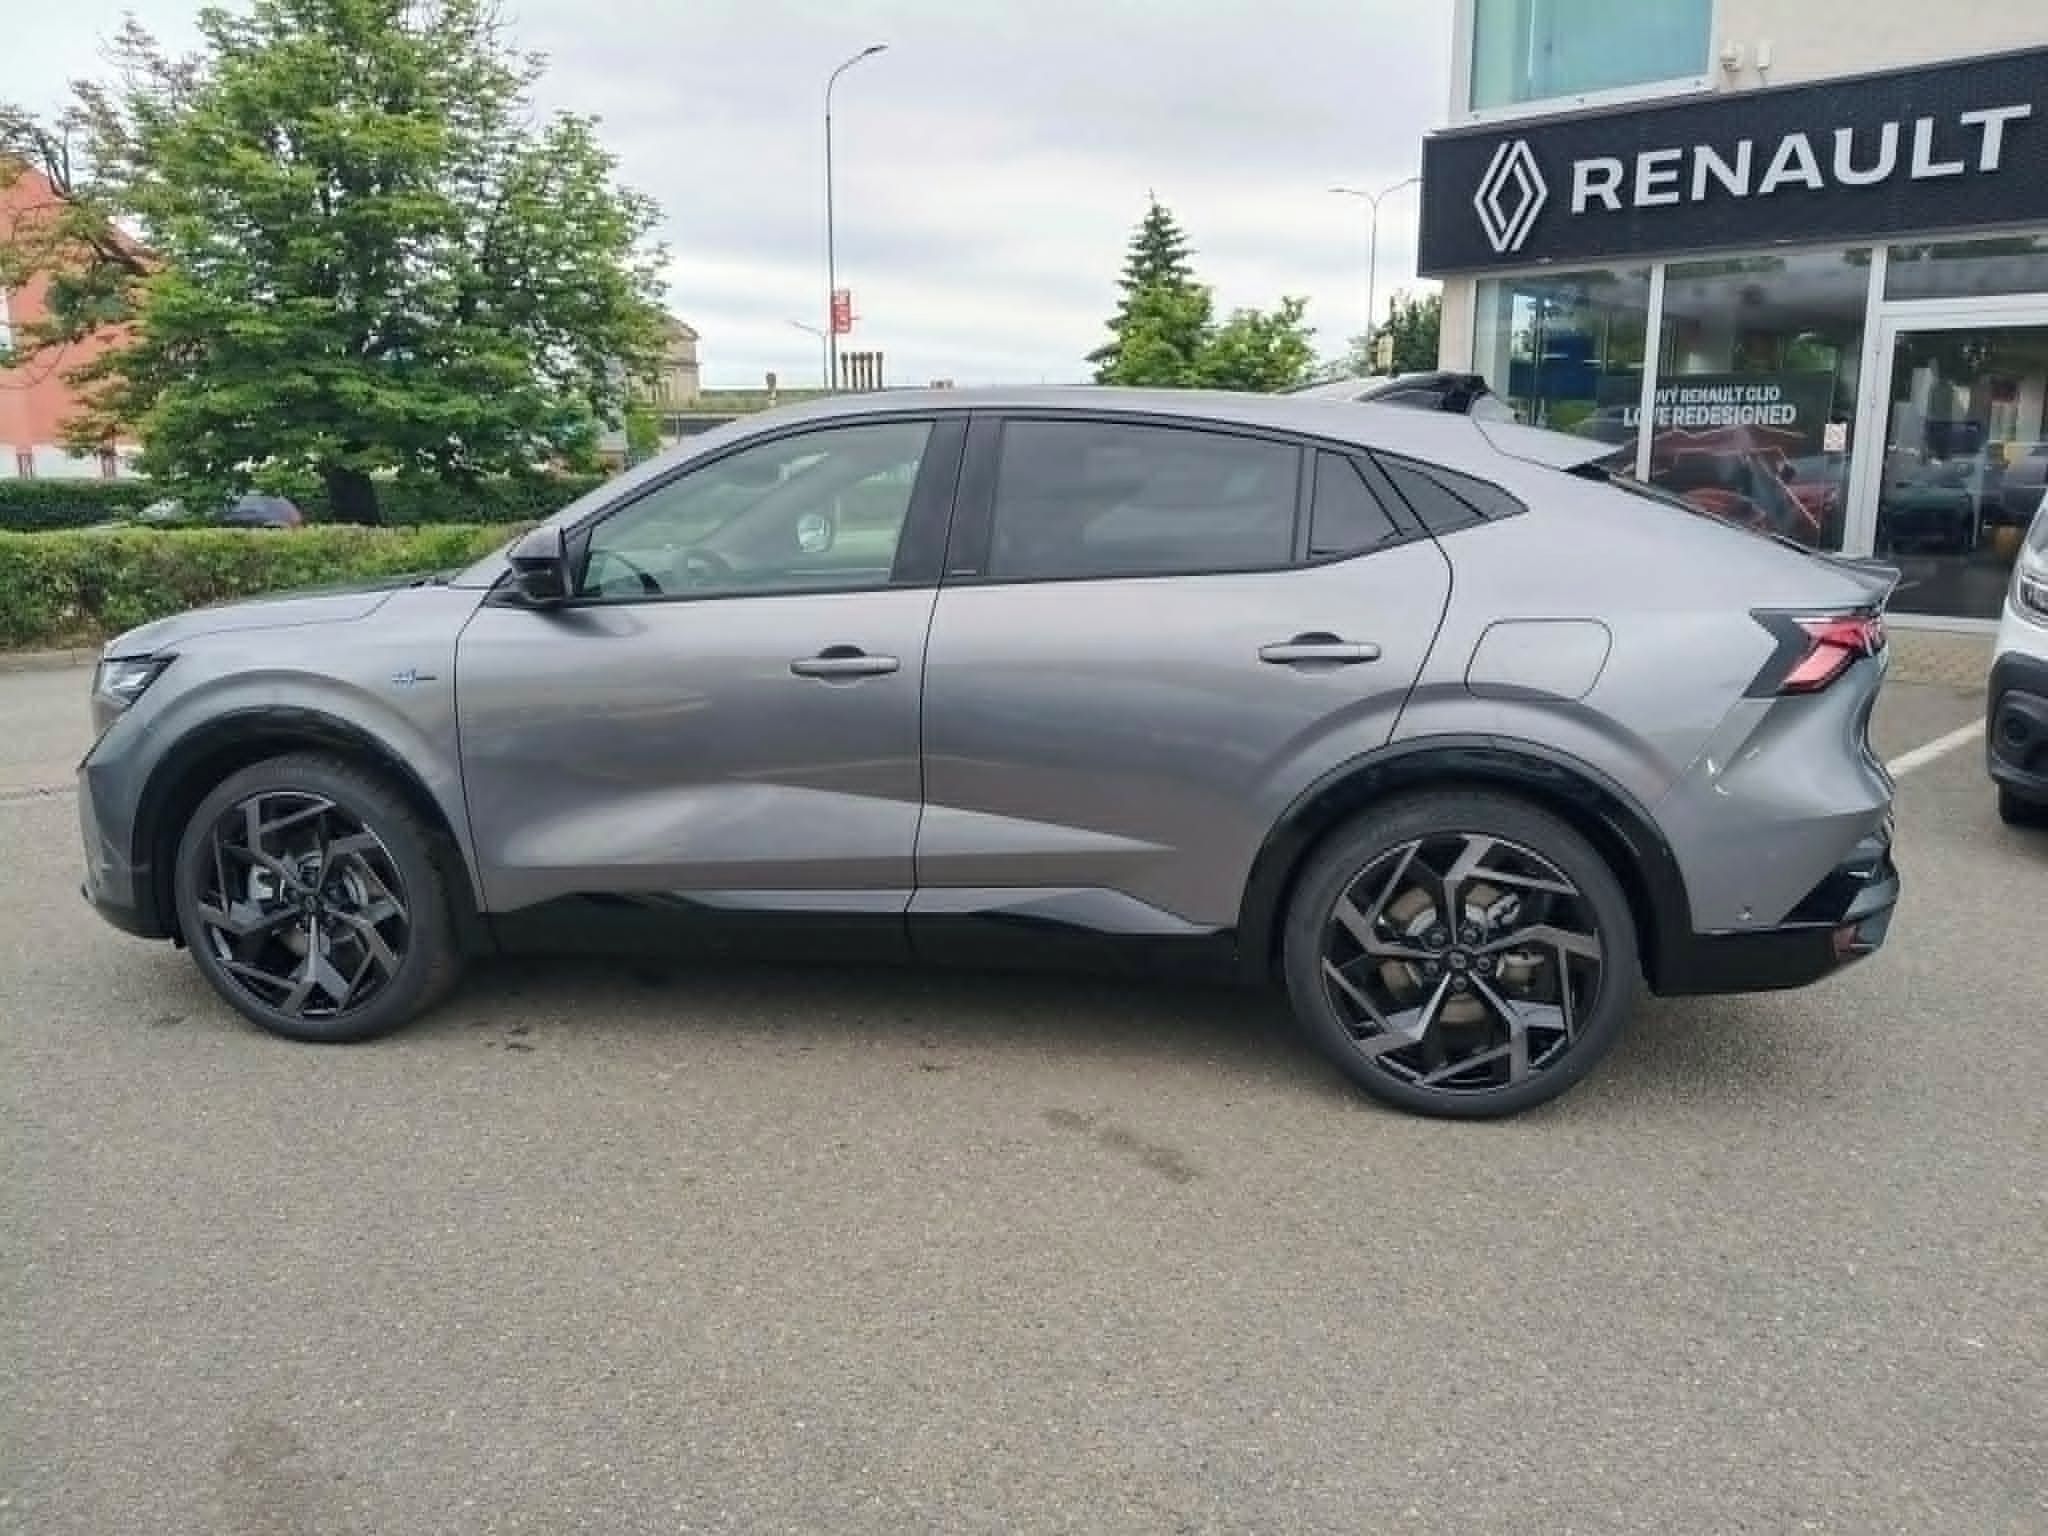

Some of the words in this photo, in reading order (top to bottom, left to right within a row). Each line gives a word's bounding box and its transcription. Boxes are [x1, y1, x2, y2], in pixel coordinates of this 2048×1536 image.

[1571, 104, 2032, 214] RENAULT
[1680, 384, 1743, 403] RENAULT
[1745, 384, 1780, 401] CLIO
[1624, 406, 1672, 427] LOE
[1672, 404, 1797, 425] REDESIGNED
